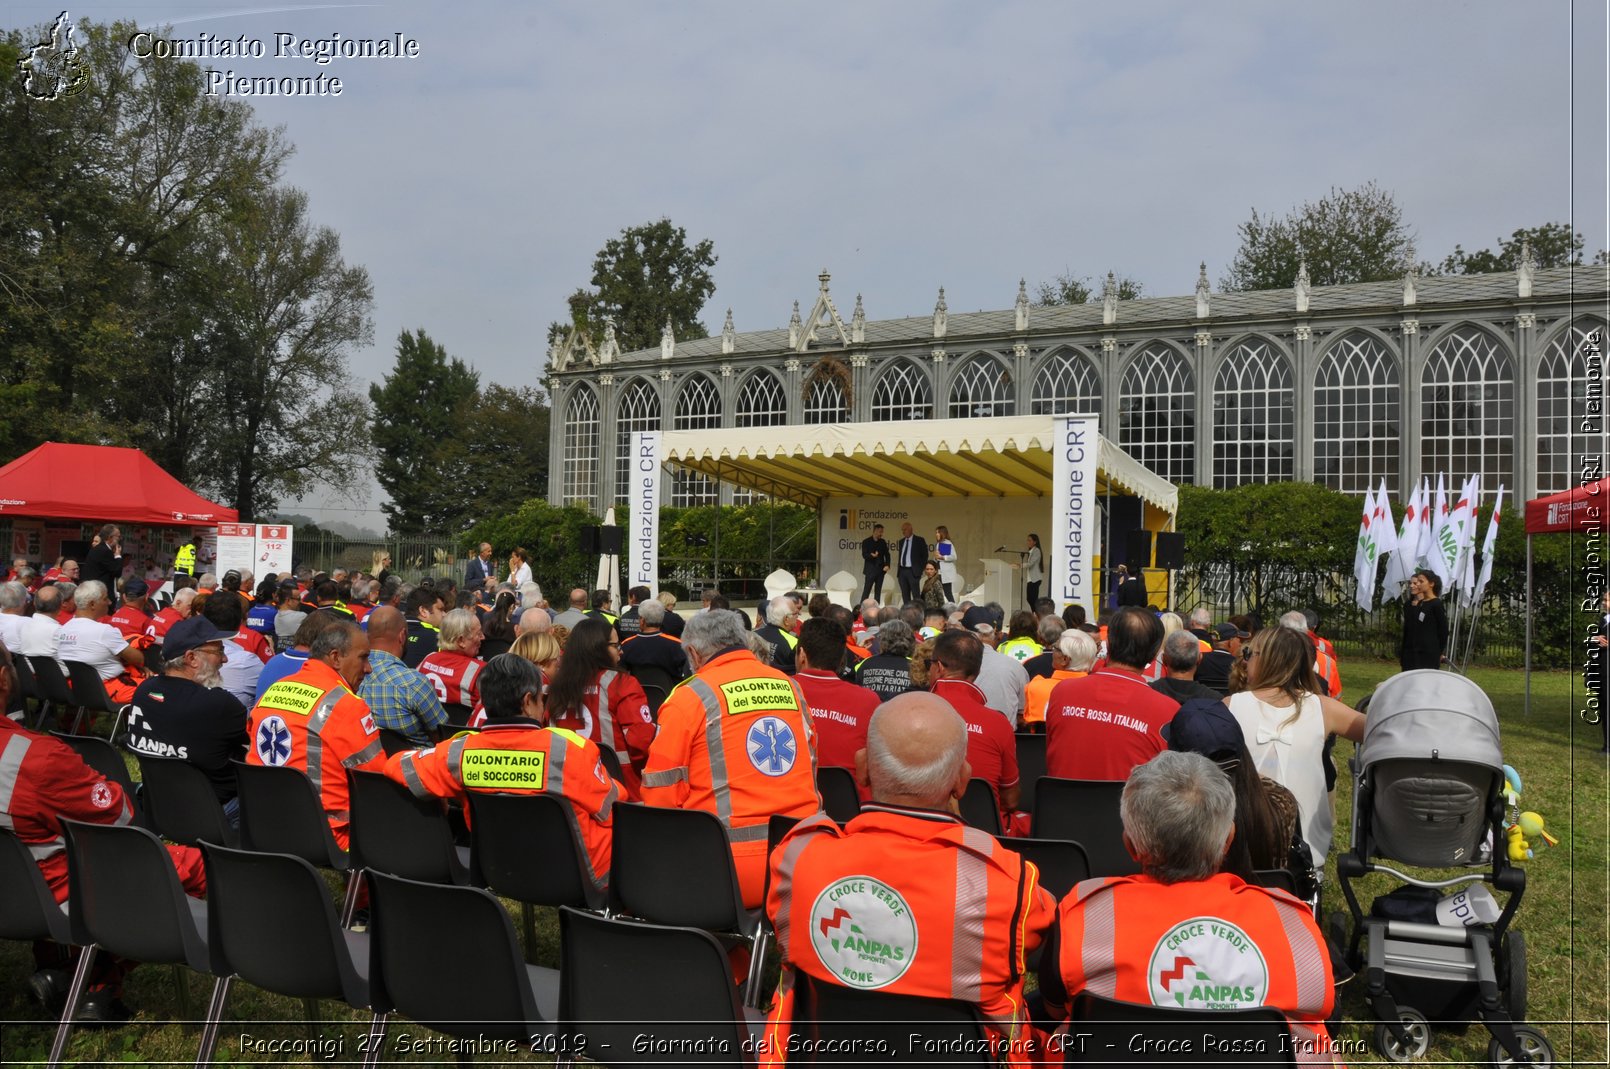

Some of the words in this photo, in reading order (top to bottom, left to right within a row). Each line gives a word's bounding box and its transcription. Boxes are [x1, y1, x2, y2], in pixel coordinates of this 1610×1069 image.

[1066, 417, 1086, 463] CRT
[640, 432, 654, 473] CRT
[859, 509, 909, 519] Fondazione
[638, 477, 654, 583] Fondazione
[1064, 470, 1084, 600] Fondazione
[863, 668, 895, 677] PROTEZIONE
[269, 685, 319, 699] VOLONTARIO
[727, 683, 791, 694] VOLONTARIO
[272, 695, 309, 709] SOCCORSO
[733, 697, 749, 707] del
[751, 695, 793, 704] SOCCORSO
[810, 707, 828, 719] OSSA
[829, 710, 857, 726] ITALIANA
[1062, 706, 1086, 718] CROCE
[1086, 709, 1112, 723] ROSSA
[1113, 713, 1149, 734] ITALIANA
[136, 736, 188, 759] ANPAS
[465, 755, 540, 767] VOLONTARIO
[466, 771, 480, 781] del
[483, 771, 537, 782] SOCCORSO
[829, 883, 865, 902] CROCE
[871, 884, 904, 917] VERDE
[843, 935, 904, 961] ANPAS
[1166, 924, 1205, 951] CROCE
[1211, 924, 1249, 954] VERDE
[858, 953, 886, 965] PIEMONTE
[842, 966, 874, 983] NONE
[1188, 985, 1255, 1003] ANPAS
